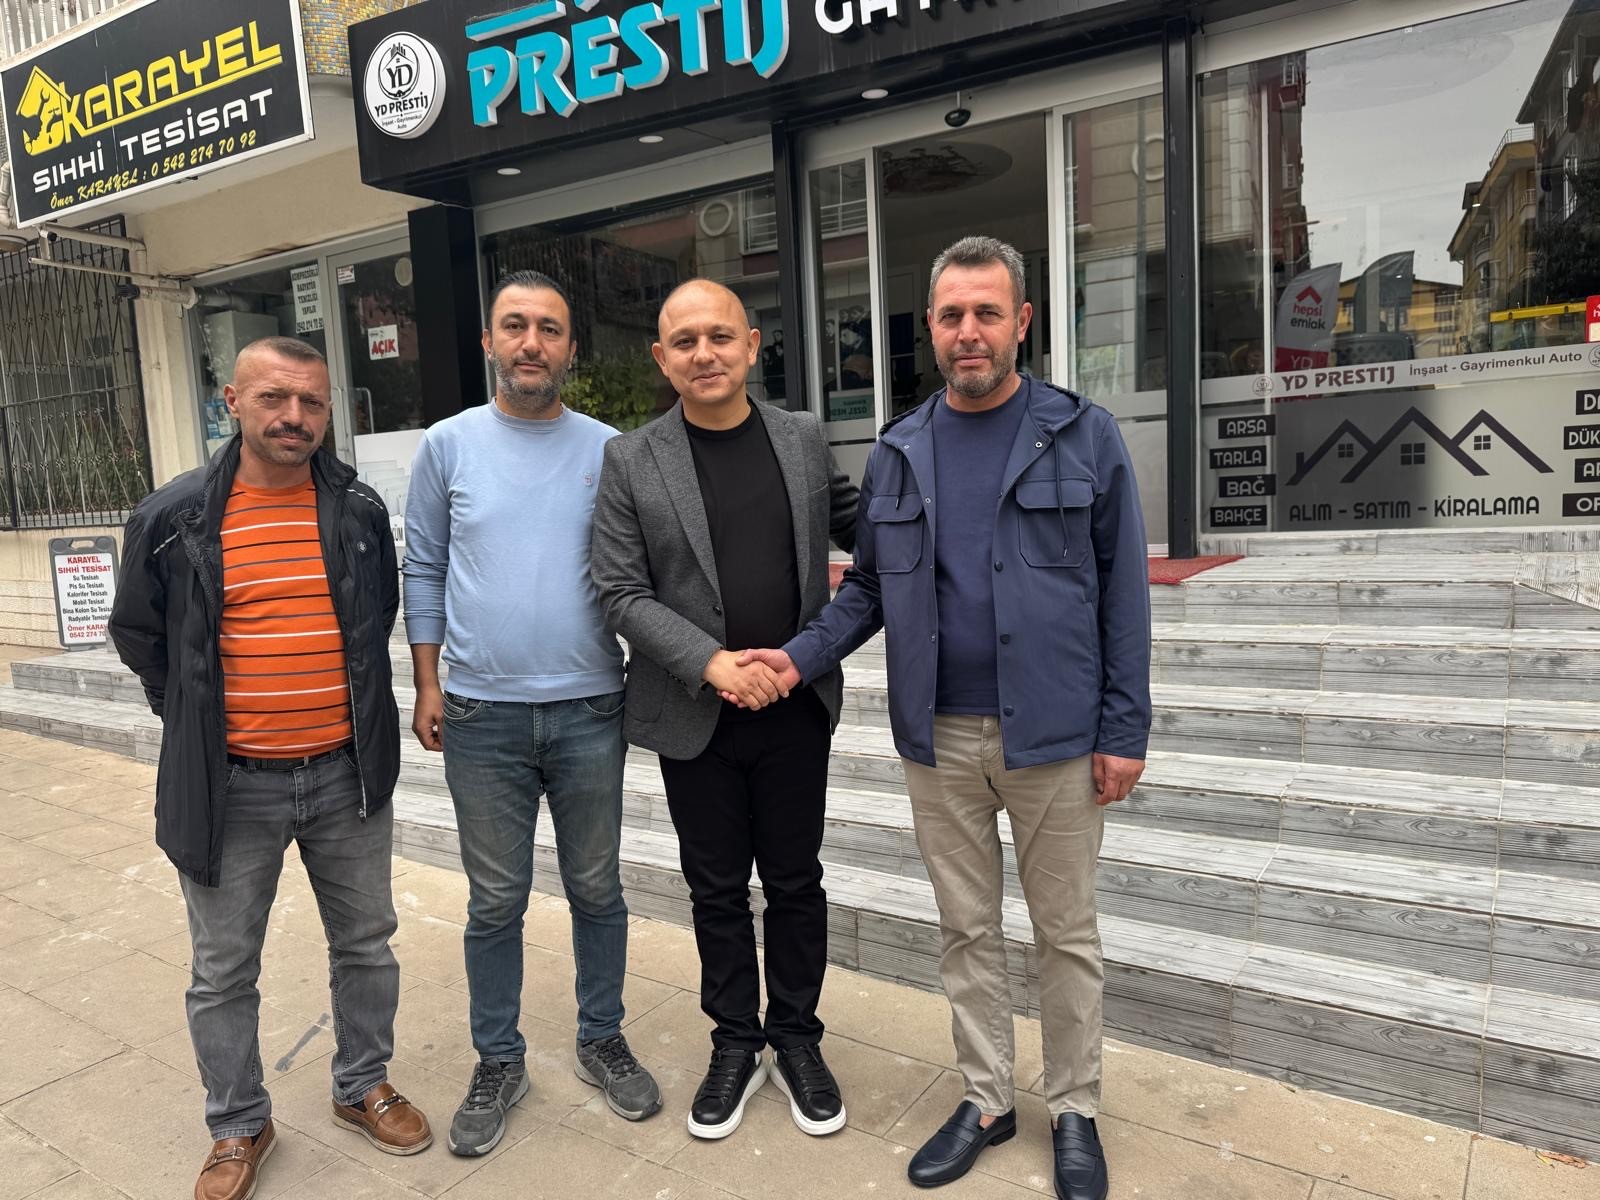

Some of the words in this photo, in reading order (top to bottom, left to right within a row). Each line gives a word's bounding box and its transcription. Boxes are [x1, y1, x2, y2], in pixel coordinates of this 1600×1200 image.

[59, 21, 282, 144] KARAYEL
[386, 63, 413, 89] YD
[374, 104, 388, 118] YD
[389, 91, 428, 114] PRESTİJ
[33, 141, 104, 193] SIHHİ
[120, 88, 273, 161] TESİSAT
[51, 192, 74, 209] Ömer
[78, 168, 138, 200] KARAYEL
[151, 162, 159, 177] 0
[163, 152, 185, 174] 542
[190, 143, 213, 165] 274
[219, 137, 234, 155] 70
[240, 129, 256, 149] 92
[1293, 304, 1323, 317] hepsi
[1290, 317, 1326, 330] emlak
[371, 338, 397, 358] AÇIK
[1282, 374, 1309, 392] YD
[1315, 366, 1395, 388] PRESTIJ
[1409, 364, 1448, 377] İnşaat
[1460, 354, 1545, 373] Gayrimenkul
[1549, 351, 1583, 364] Auto
[1291, 355, 1314, 369] YD
[1227, 419, 1266, 435] ARSA
[1214, 450, 1262, 466] TARLA
[1227, 475, 1265, 496] BAĞ
[1215, 509, 1262, 525] BAHÇE
[1289, 503, 1332, 522] ALIM
[1353, 500, 1411, 520] SATIM
[1434, 495, 1540, 517] KİRALAMA
[58, 566, 79, 574] SIHHİ
[82, 565, 111, 573] TESİSAT
[67, 556, 101, 564] KARAYEL
